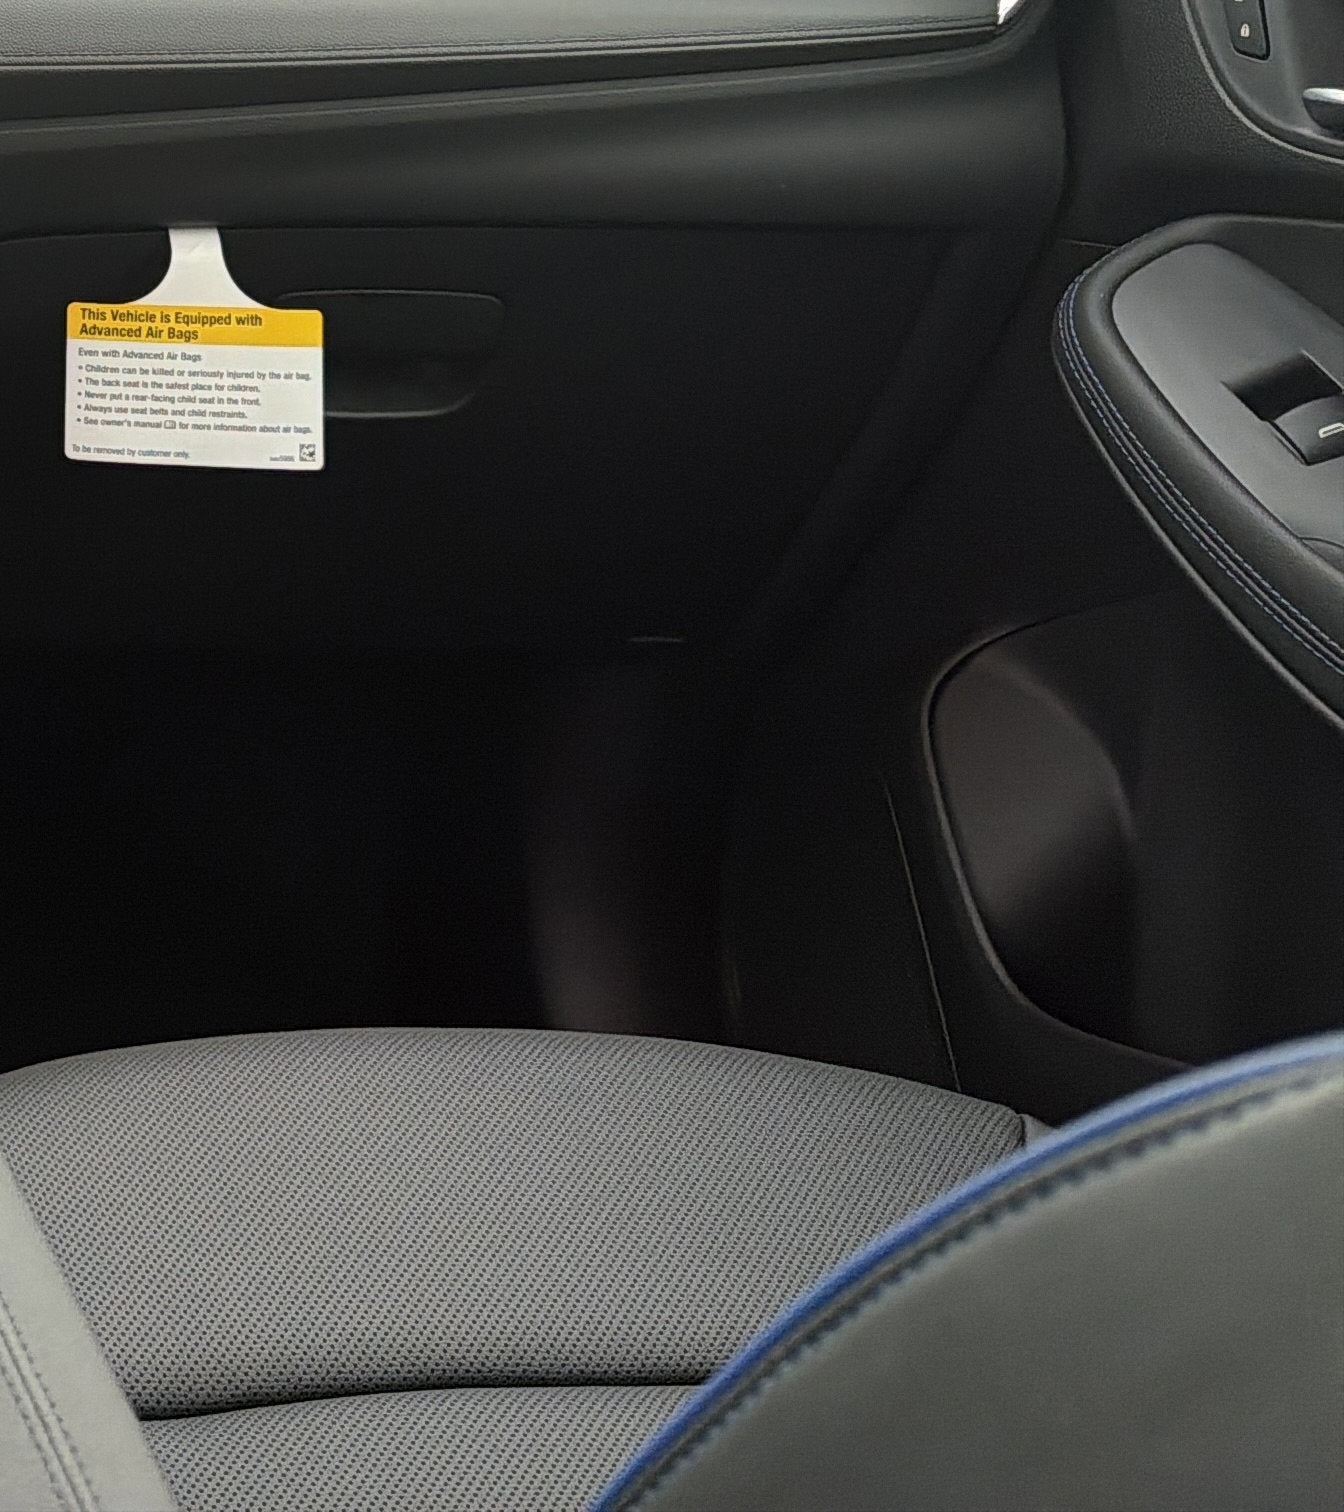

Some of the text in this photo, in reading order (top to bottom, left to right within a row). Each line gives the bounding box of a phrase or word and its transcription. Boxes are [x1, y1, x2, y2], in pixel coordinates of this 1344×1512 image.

[80, 308, 263, 328] This Vehicle is Equipped with
[79, 323, 199, 343] Advanced Air Bags
[78, 347, 202, 362] Even with Advanced Air Bags
[85, 364, 120, 374] Children
[122, 366, 137, 375] can
[139, 366, 149, 375] be
[177, 369, 185, 377] or
[188, 369, 224, 379] seriously
[226, 369, 254, 380] injured
[257, 370, 266, 381] by
[269, 371, 281, 379] the
[283, 371, 293, 380] air
[85, 377, 99, 386] The
[102, 378, 121, 387] back
[123, 379, 139, 388] seat
[151, 380, 163, 389] the
[165, 380, 189, 390] safest
[191, 382, 212, 391] place
[214, 382, 225, 391] for
[84, 390, 107, 400] Never
[109, 391, 122, 401] put
[177, 394, 196, 404] child
[198, 397, 216, 405] seat
[217, 396, 224, 405] in
[227, 396, 239, 405] the
[83, 403, 112, 414] Always
[114, 406, 128, 414] use
[131, 405, 147, 415] seat
[149, 406, 168, 415] belts
[170, 407, 185, 416] and
[188, 407, 206, 417] child
[83, 417, 98, 425] See
[133, 419, 162, 429] manual
[178, 420, 189, 429] for
[191, 422, 211, 430] more
[213, 422, 257, 432] information
[259, 424, 280, 433] about
[72, 443, 80, 452] To
[82, 444, 91, 453] be
[93, 445, 125, 455] removed
[127, 447, 136, 457] by
[138, 447, 171, 457] customer
